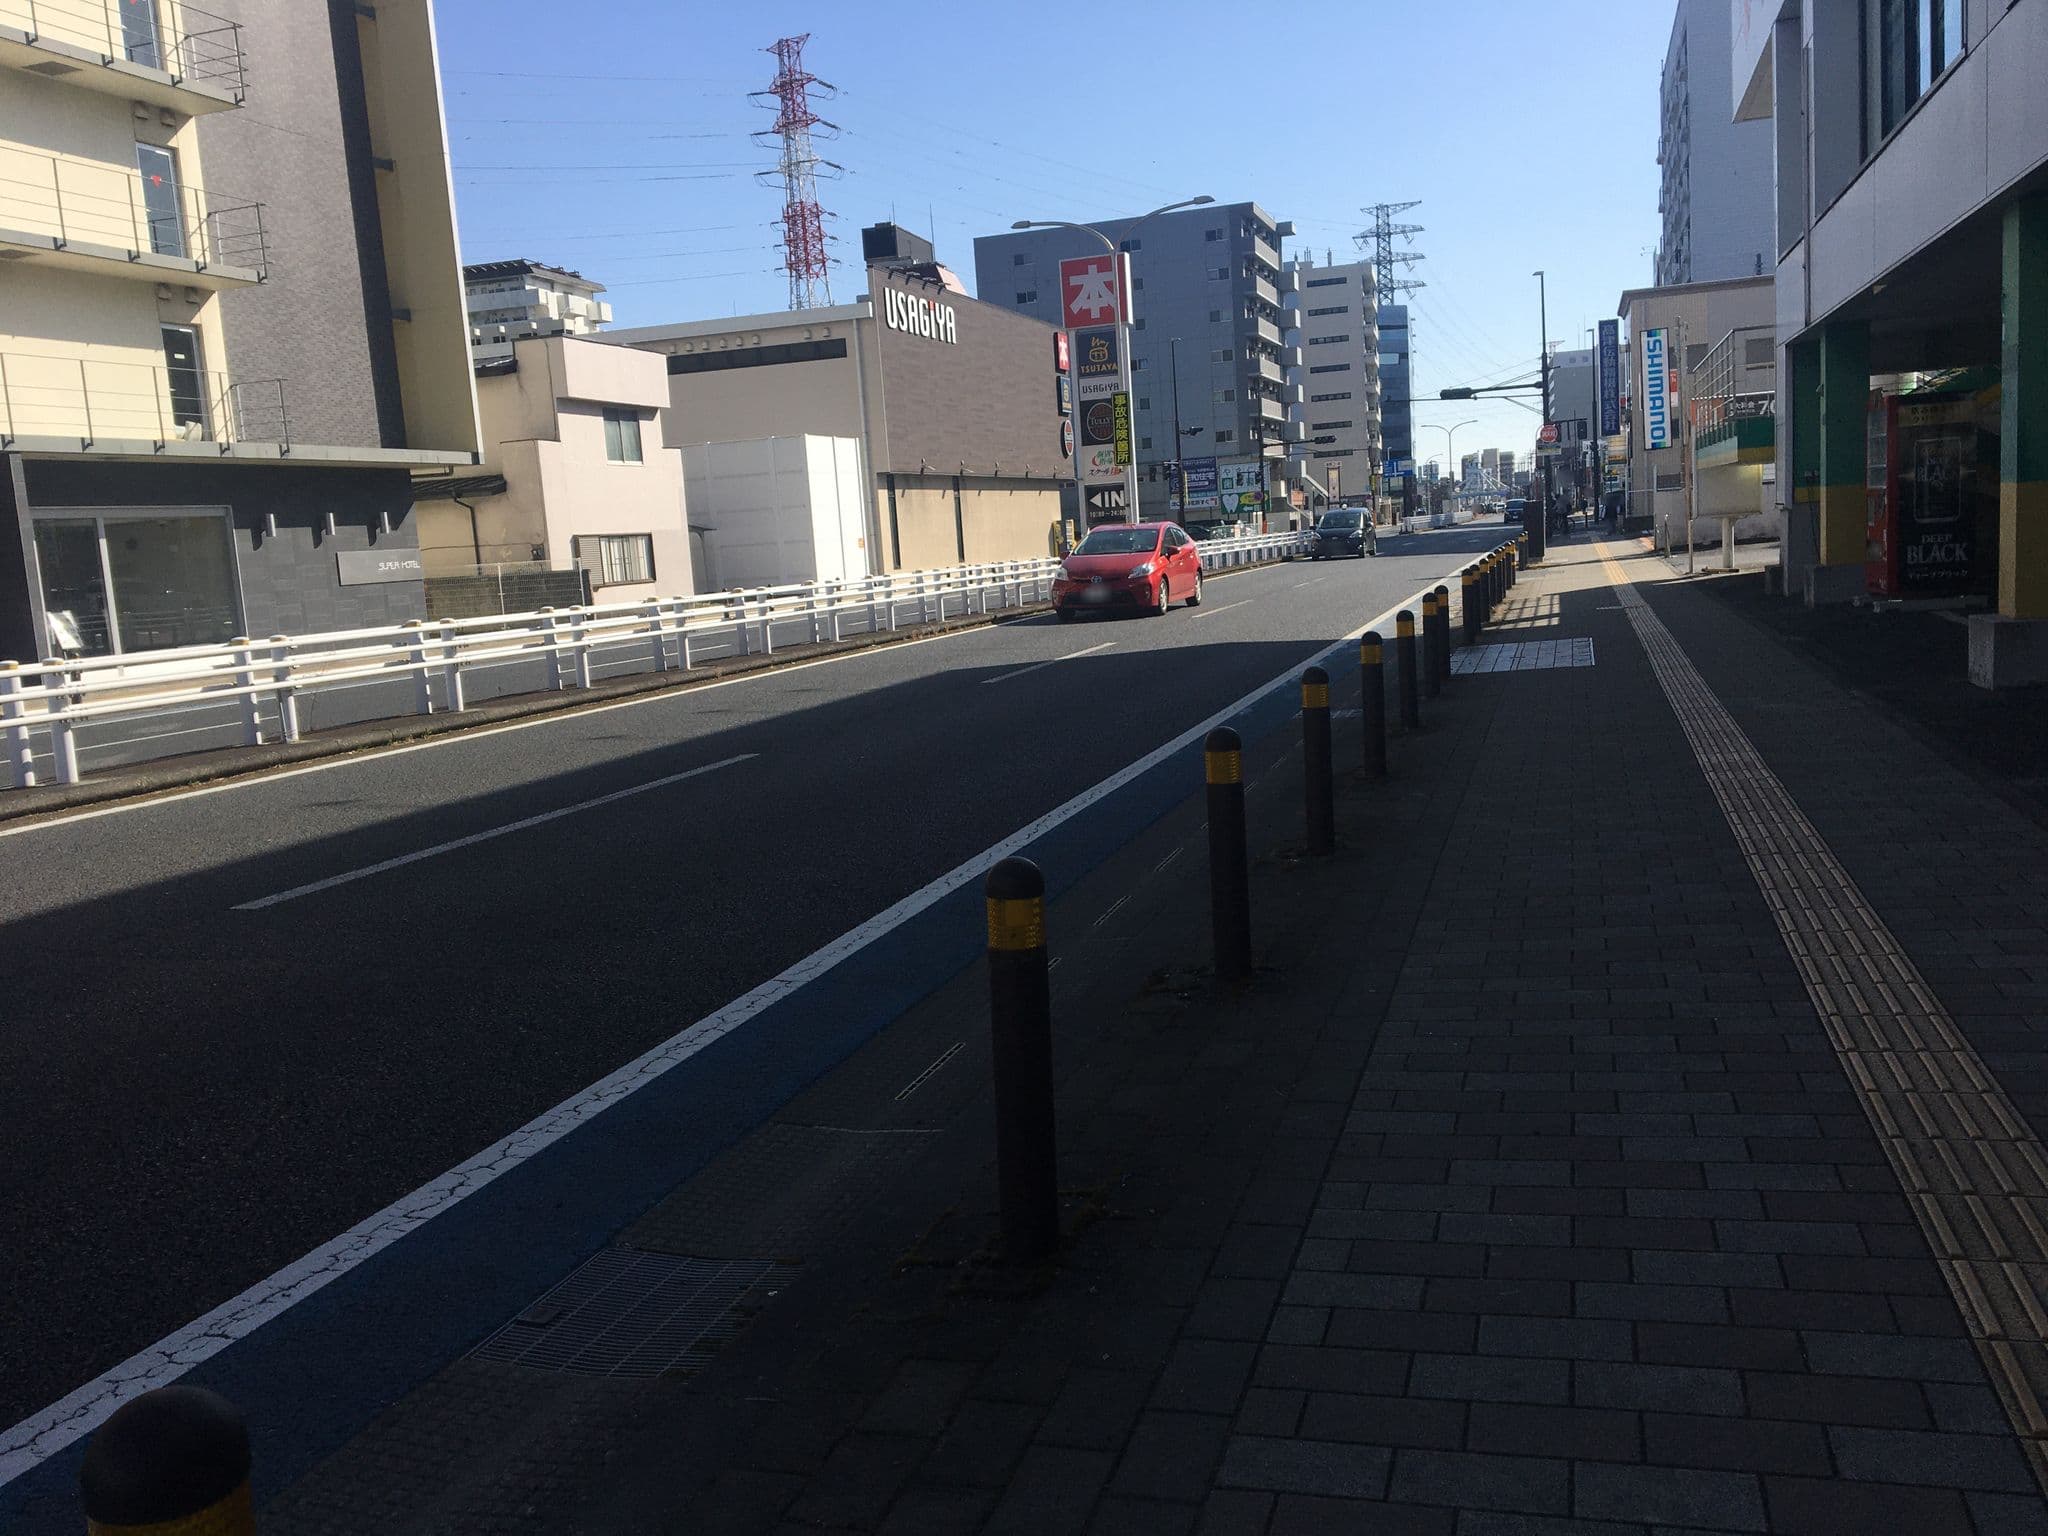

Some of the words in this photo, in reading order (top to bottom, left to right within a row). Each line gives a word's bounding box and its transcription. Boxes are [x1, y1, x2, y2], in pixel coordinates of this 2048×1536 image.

[1069, 264, 1116, 319] 本
[883, 286, 957, 345] USAGIYA
[1081, 363, 1119, 374] TSUTAYA
[1082, 382, 1119, 394] USAGIYA
[1647, 338, 1666, 440] SHIMANO
[1114, 395, 1129, 463] 事故危険箇所
[1104, 490, 1125, 508] IN
[1906, 543, 1969, 564] BLACK
[378, 561, 400, 571] SUPER
[401, 560, 421, 569] HOTEL
